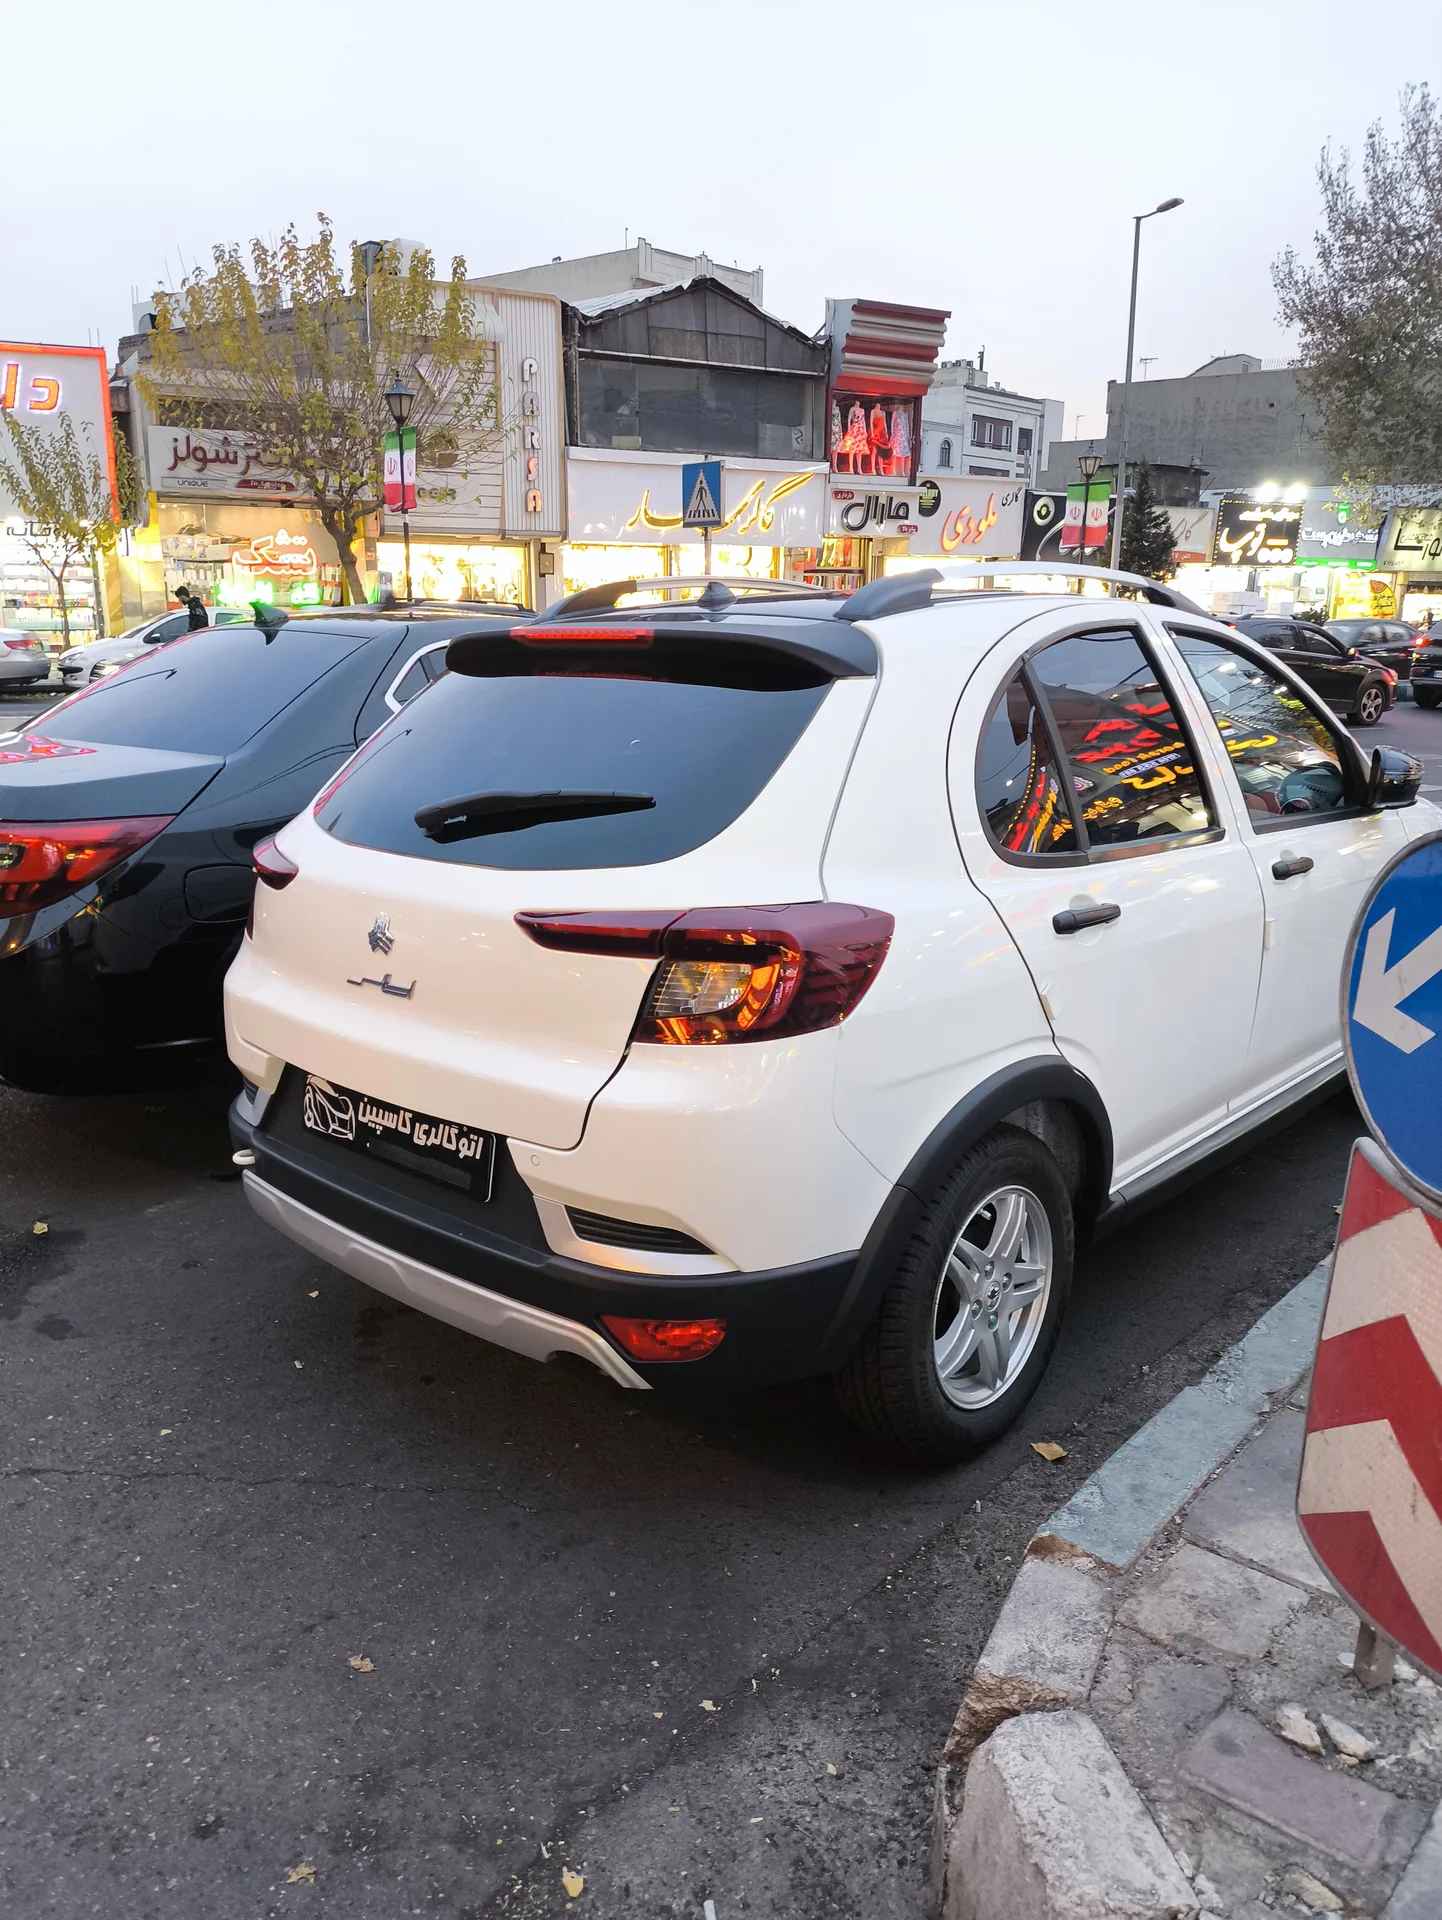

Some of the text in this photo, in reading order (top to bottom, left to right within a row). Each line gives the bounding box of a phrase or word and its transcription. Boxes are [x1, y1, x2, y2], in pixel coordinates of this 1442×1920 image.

[167, 433, 238, 473] شولز
[521, 356, 543, 513] PARSA
[177, 478, 209, 488] UNIQUE
[1001, 486, 1023, 507] گالری
[940, 492, 998, 553] ملودی
